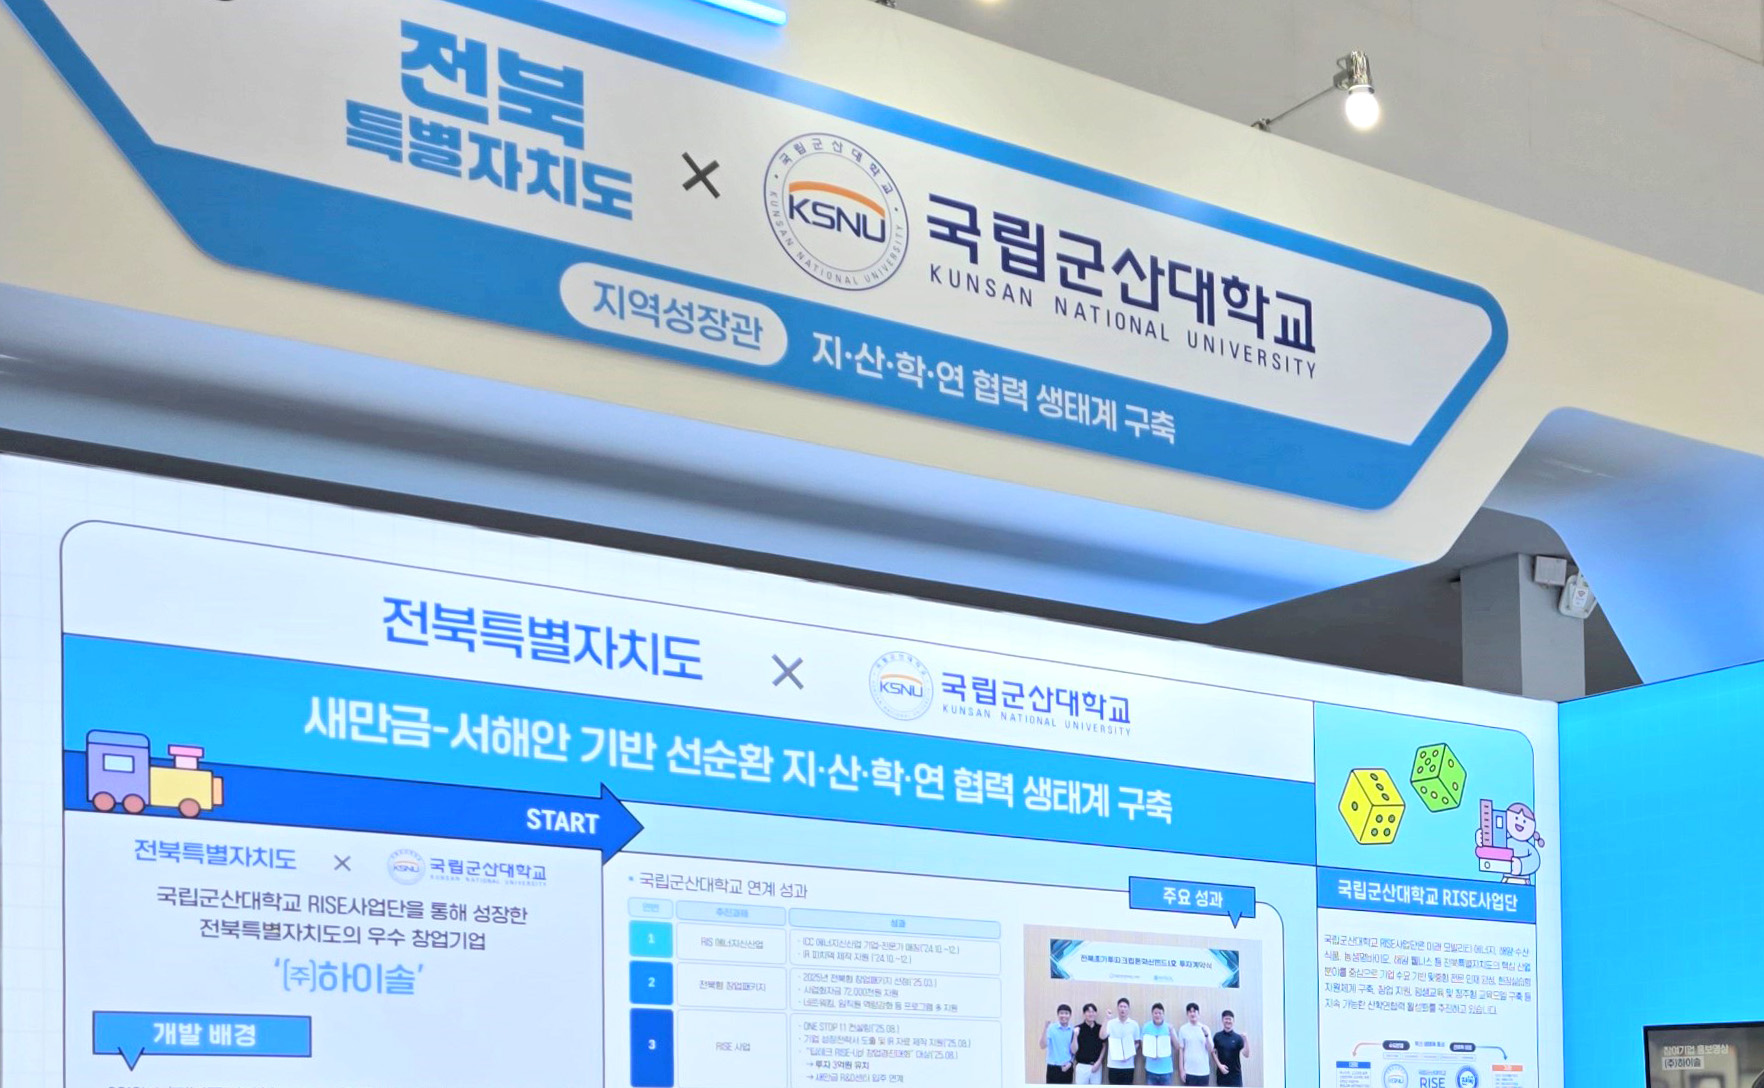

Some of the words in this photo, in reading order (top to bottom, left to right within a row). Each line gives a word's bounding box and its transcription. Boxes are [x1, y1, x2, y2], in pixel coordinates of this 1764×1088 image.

[400, 19, 585, 151] 전북
[346, 100, 633, 221] 특별자치도
[789, 194, 886, 243] KSNU
[927, 193, 1316, 353] 국립군산대학교
[593, 280, 764, 351] 지역성장관
[930, 263, 1034, 307] KUNSAN
[1055, 295, 1170, 342] NATIONAL
[1187, 330, 1316, 380] UNIVERSITY
[812, 331, 966, 396] 지·산·학·연
[973, 369, 1028, 412] 협력
[1036, 383, 1118, 433] 생태계
[1125, 404, 1177, 445] 구축
[382, 596, 704, 682] 전북특별자치도
[879, 679, 924, 699] KSNU
[941, 672, 1131, 724] 국립군산대학교
[942, 704, 991, 720] KUNSAN
[1000, 711, 1057, 728] NATIONAL
[1064, 719, 1131, 737] UNIVERSITY
[304, 696, 571, 763] 새만금-서해안
[581, 726, 657, 771] 기반
[666, 734, 773, 783] 선순환
[782, 747, 945, 800] 지·산·학·연
[954, 766, 1013, 807] 협력
[1022, 775, 1110, 823] 생태계
[1118, 786, 1174, 825] 구축
[526, 808, 600, 835] START
[134, 839, 297, 871] 전북특별자치도
[430, 857, 547, 881] 국립군산대학교
[156, 885, 302, 914] 국립군산대학교
[308, 893, 425, 921] RISE사업단을
[431, 902, 467, 923] 통해
[473, 904, 529, 926] 성장한
[639, 872, 743, 896] 국립군산대학교
[747, 879, 775, 897] 연계
[779, 881, 808, 899] 성과
[1163, 887, 1190, 905] 주요
[1195, 889, 1223, 909] 성과
[1337, 879, 1438, 905] 국립군산대학교
[1443, 889, 1518, 912] RISE사업단
[199, 917, 362, 946] 전북특별자치도의
[367, 926, 405, 948] 우수
[411, 927, 486, 951] 창업기업
[153, 1022, 203, 1046] 개발
[208, 1022, 257, 1047] 배경
